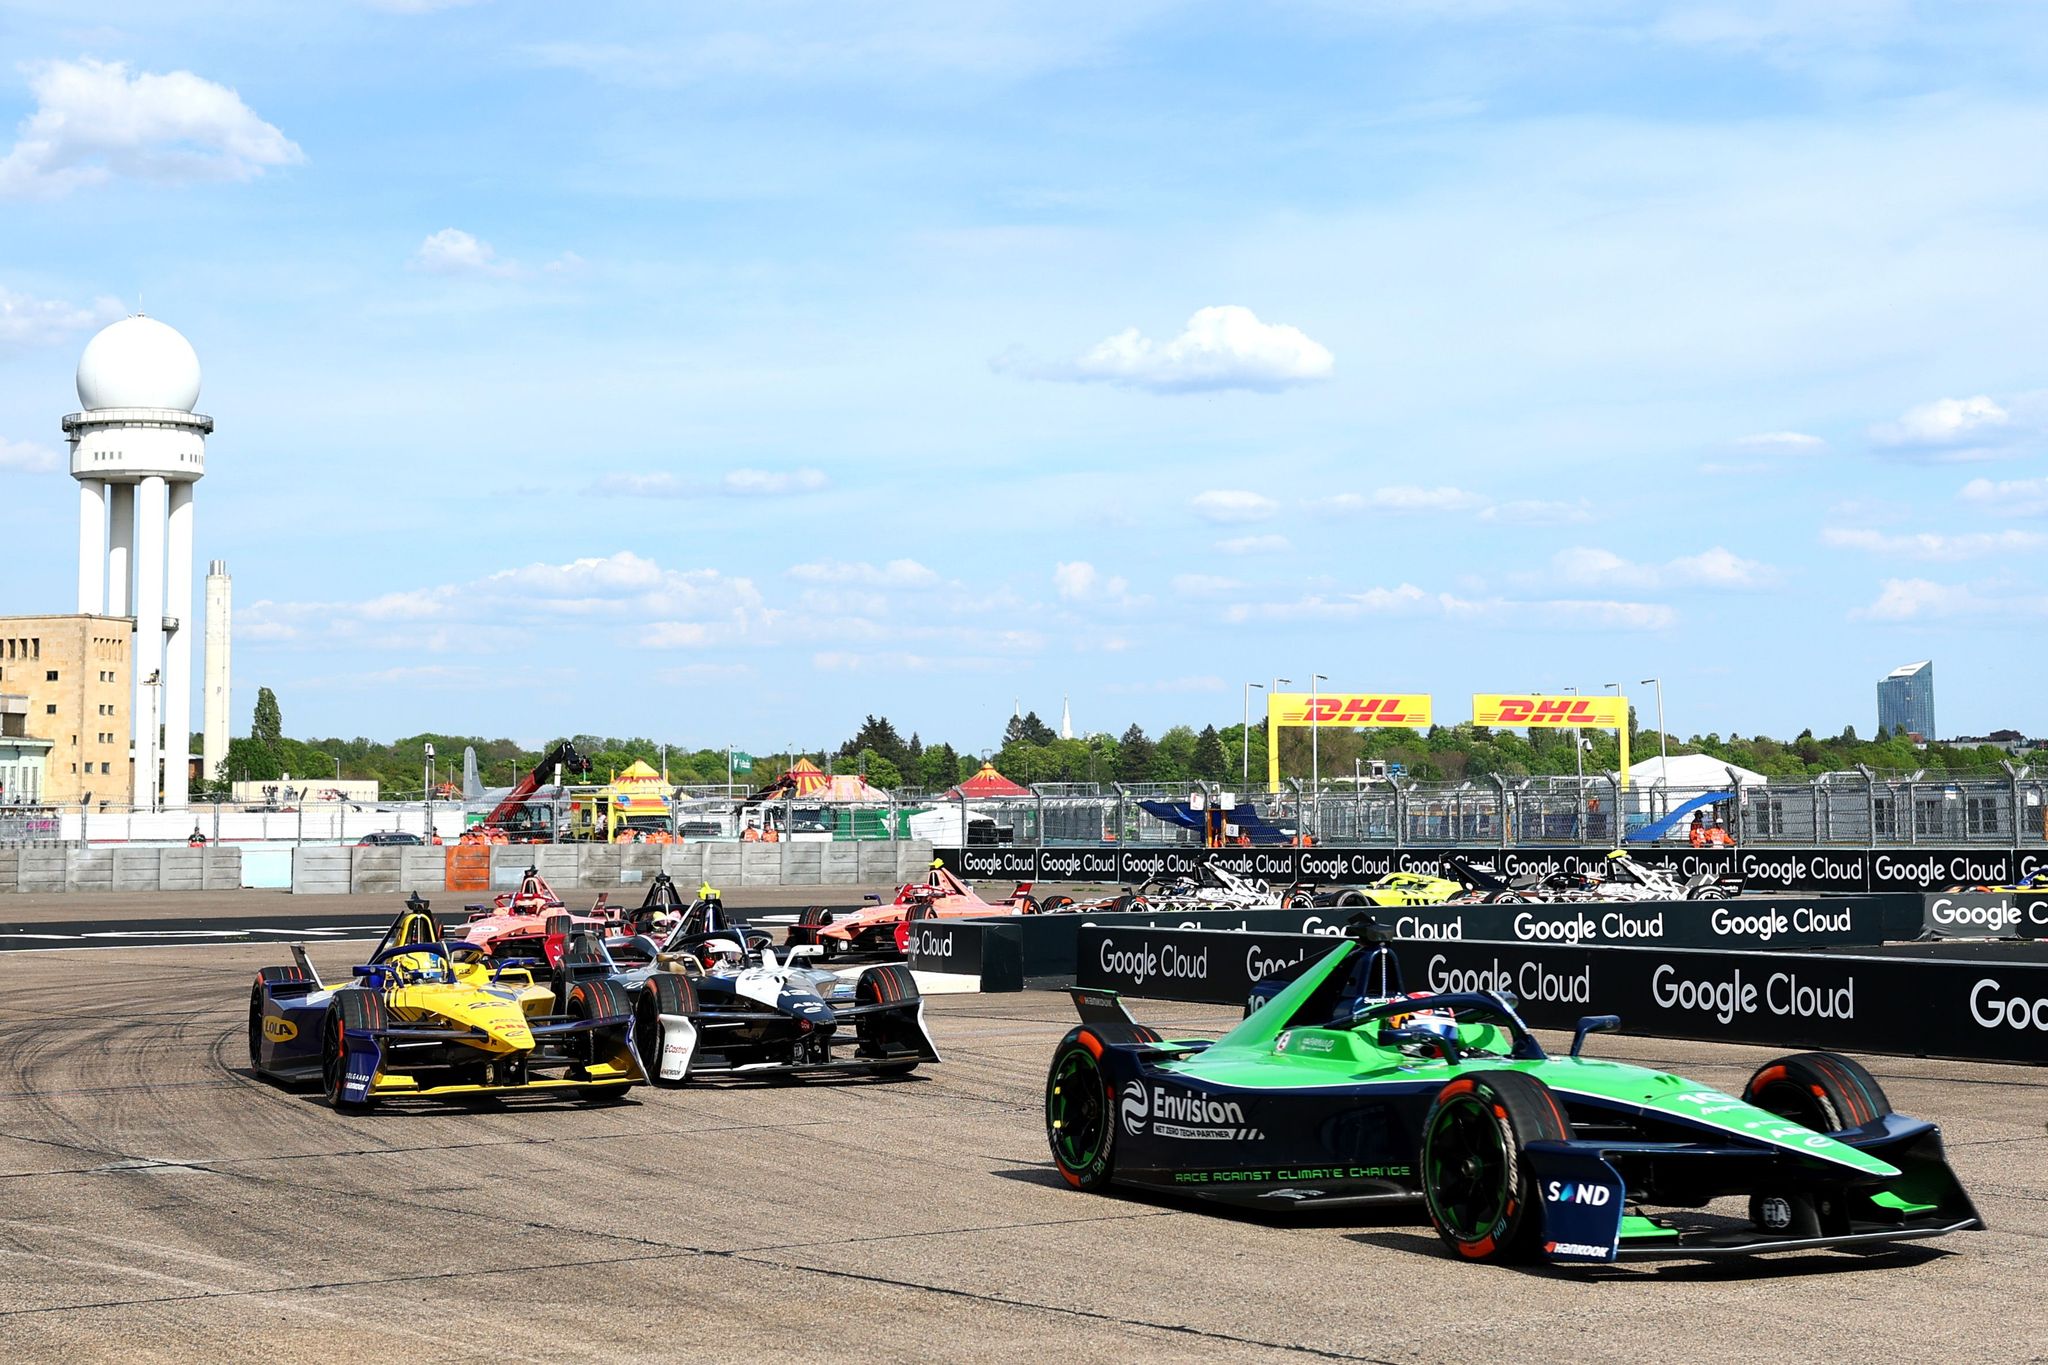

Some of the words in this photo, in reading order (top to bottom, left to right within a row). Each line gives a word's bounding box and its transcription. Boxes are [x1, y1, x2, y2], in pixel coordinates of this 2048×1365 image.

[1303, 699, 1406, 722] DHL
[1498, 700, 1596, 722] DHL
[964, 852, 1001, 875] Google
[1003, 853, 1034, 871] Cloud
[1041, 852, 1081, 876] Google
[1083, 854, 1115, 872] Cloud
[1122, 853, 1164, 876] Google
[1256, 854, 1292, 873] Cloud
[1300, 853, 1348, 879] Google
[1351, 855, 1390, 875] Cloud
[1400, 854, 1439, 878] Goog
[1505, 854, 1560, 876] Google
[1563, 856, 1608, 875] Cloud
[1682, 856, 1730, 877] Cloud
[1743, 855, 1806, 885] Google
[1810, 857, 1862, 880] Cloud
[1875, 855, 1945, 887] Google
[1950, 857, 2006, 881] Cloud
[1711, 908, 1788, 941] Google
[1793, 907, 1851, 932] Cloud
[1932, 899, 2022, 931] Google
[1396, 916, 1462, 940] Cloud
[1513, 912, 1596, 944] Google
[1601, 912, 1663, 938] Cloud
[922, 930, 953, 957] Cloud
[1100, 938, 1157, 985] Google
[1161, 944, 1207, 979] Cloud
[1428, 954, 1512, 994] Google
[1518, 961, 1590, 1003] Cloud
[1652, 964, 1758, 1025] Google
[1766, 972, 1854, 1020] Cloud
[266, 1020, 293, 1036] LOLA
[1154, 1086, 1245, 1124] Envision
[1155, 1125, 1165, 1134] NET
[1166, 1126, 1179, 1136] ZERO
[1180, 1128, 1196, 1138] TECH
[1197, 1129, 1231, 1139] PARTNER
[1176, 1173, 1208, 1182] RACE
[1213, 1171, 1271, 1181] AGAINST
[1277, 1168, 1343, 1180] CLIMATE
[1350, 1166, 1411, 1178] CHANGE
[1548, 1181, 1609, 1206] SAND
